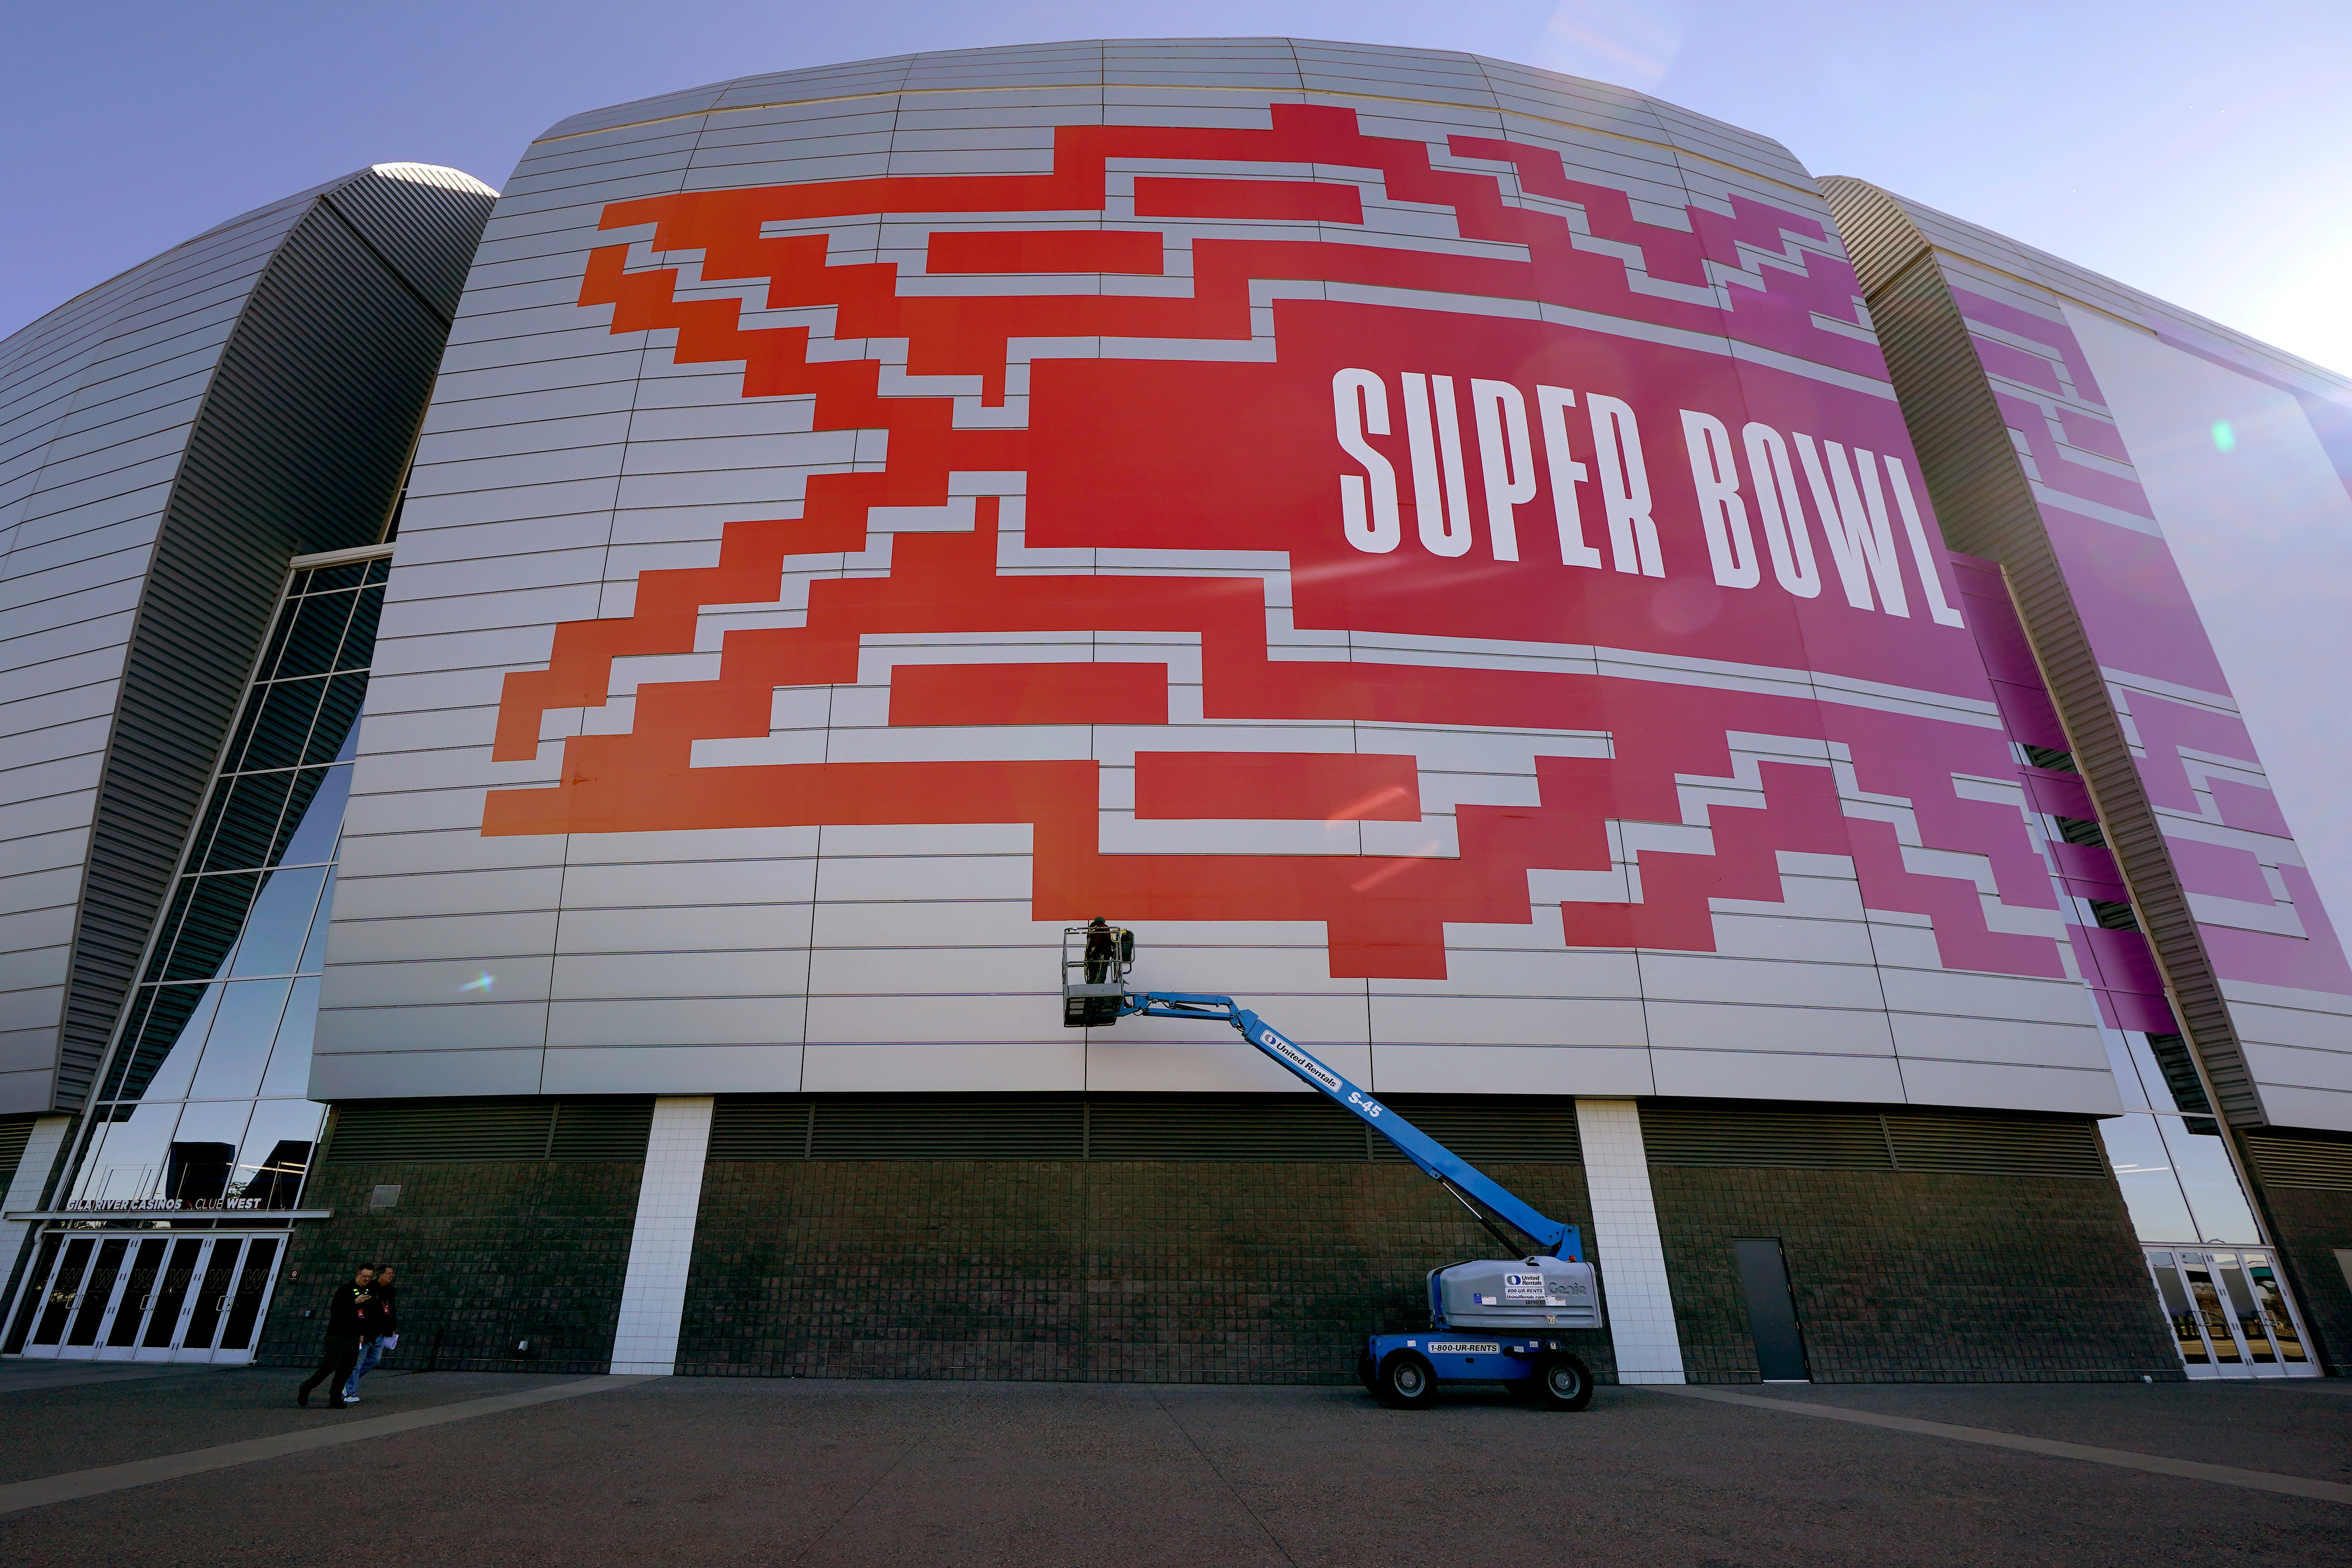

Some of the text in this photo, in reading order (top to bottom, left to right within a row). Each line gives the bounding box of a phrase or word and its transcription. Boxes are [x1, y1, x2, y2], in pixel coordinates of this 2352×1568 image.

[1333, 368, 1965, 629] SUPER BOWL
[1276, 1043, 1336, 1087] United Rentals
[1348, 1092, 1383, 1118] S-45
[67, 1198, 262, 1210] GILA RIVER CASINOS CLUB WEST
[1548, 1282, 1587, 1295] Genie
